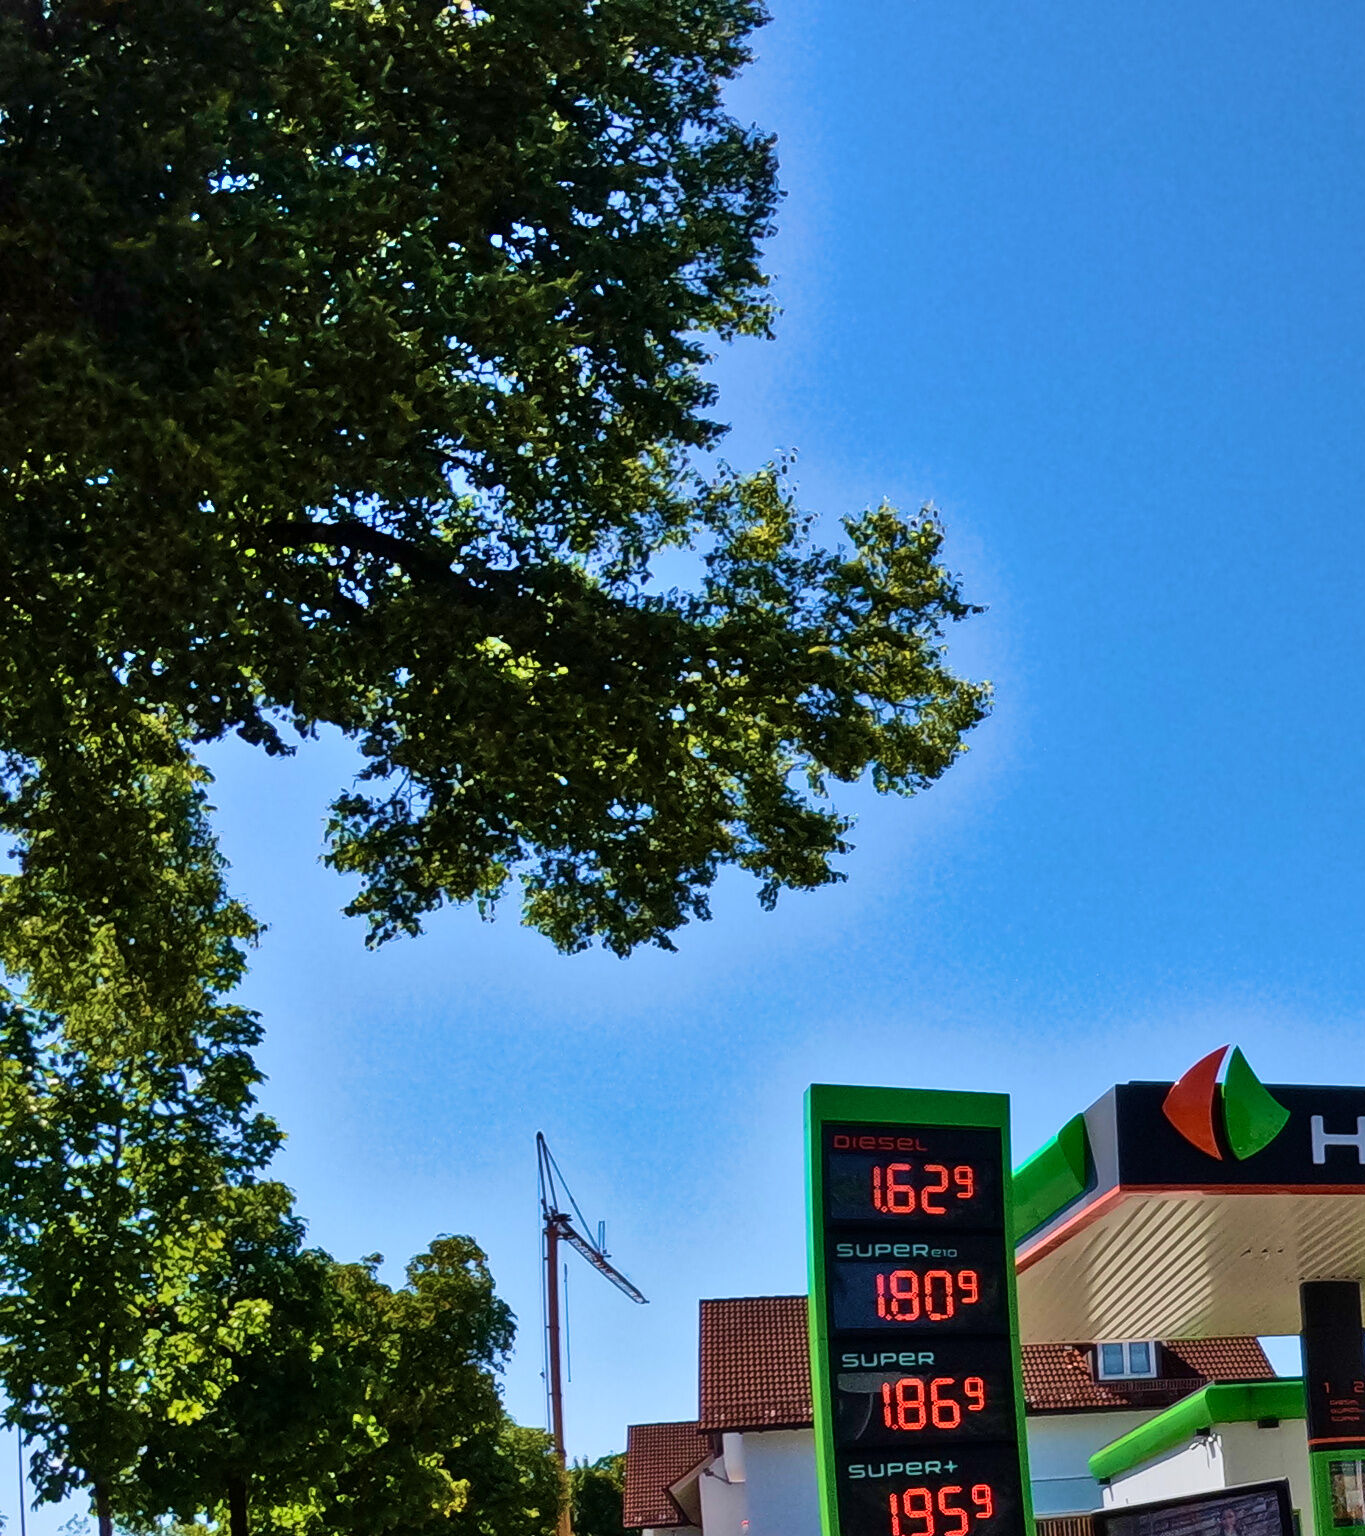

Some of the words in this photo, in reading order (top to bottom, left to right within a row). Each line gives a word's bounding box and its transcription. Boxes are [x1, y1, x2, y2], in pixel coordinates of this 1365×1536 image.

[836, 1243, 930, 1258] SUPER
[842, 1352, 936, 1368] SUPER
[1323, 1382, 1330, 1393] 1
[1353, 1380, 1365, 1393] 2
[848, 1460, 959, 1479] SUPER+
